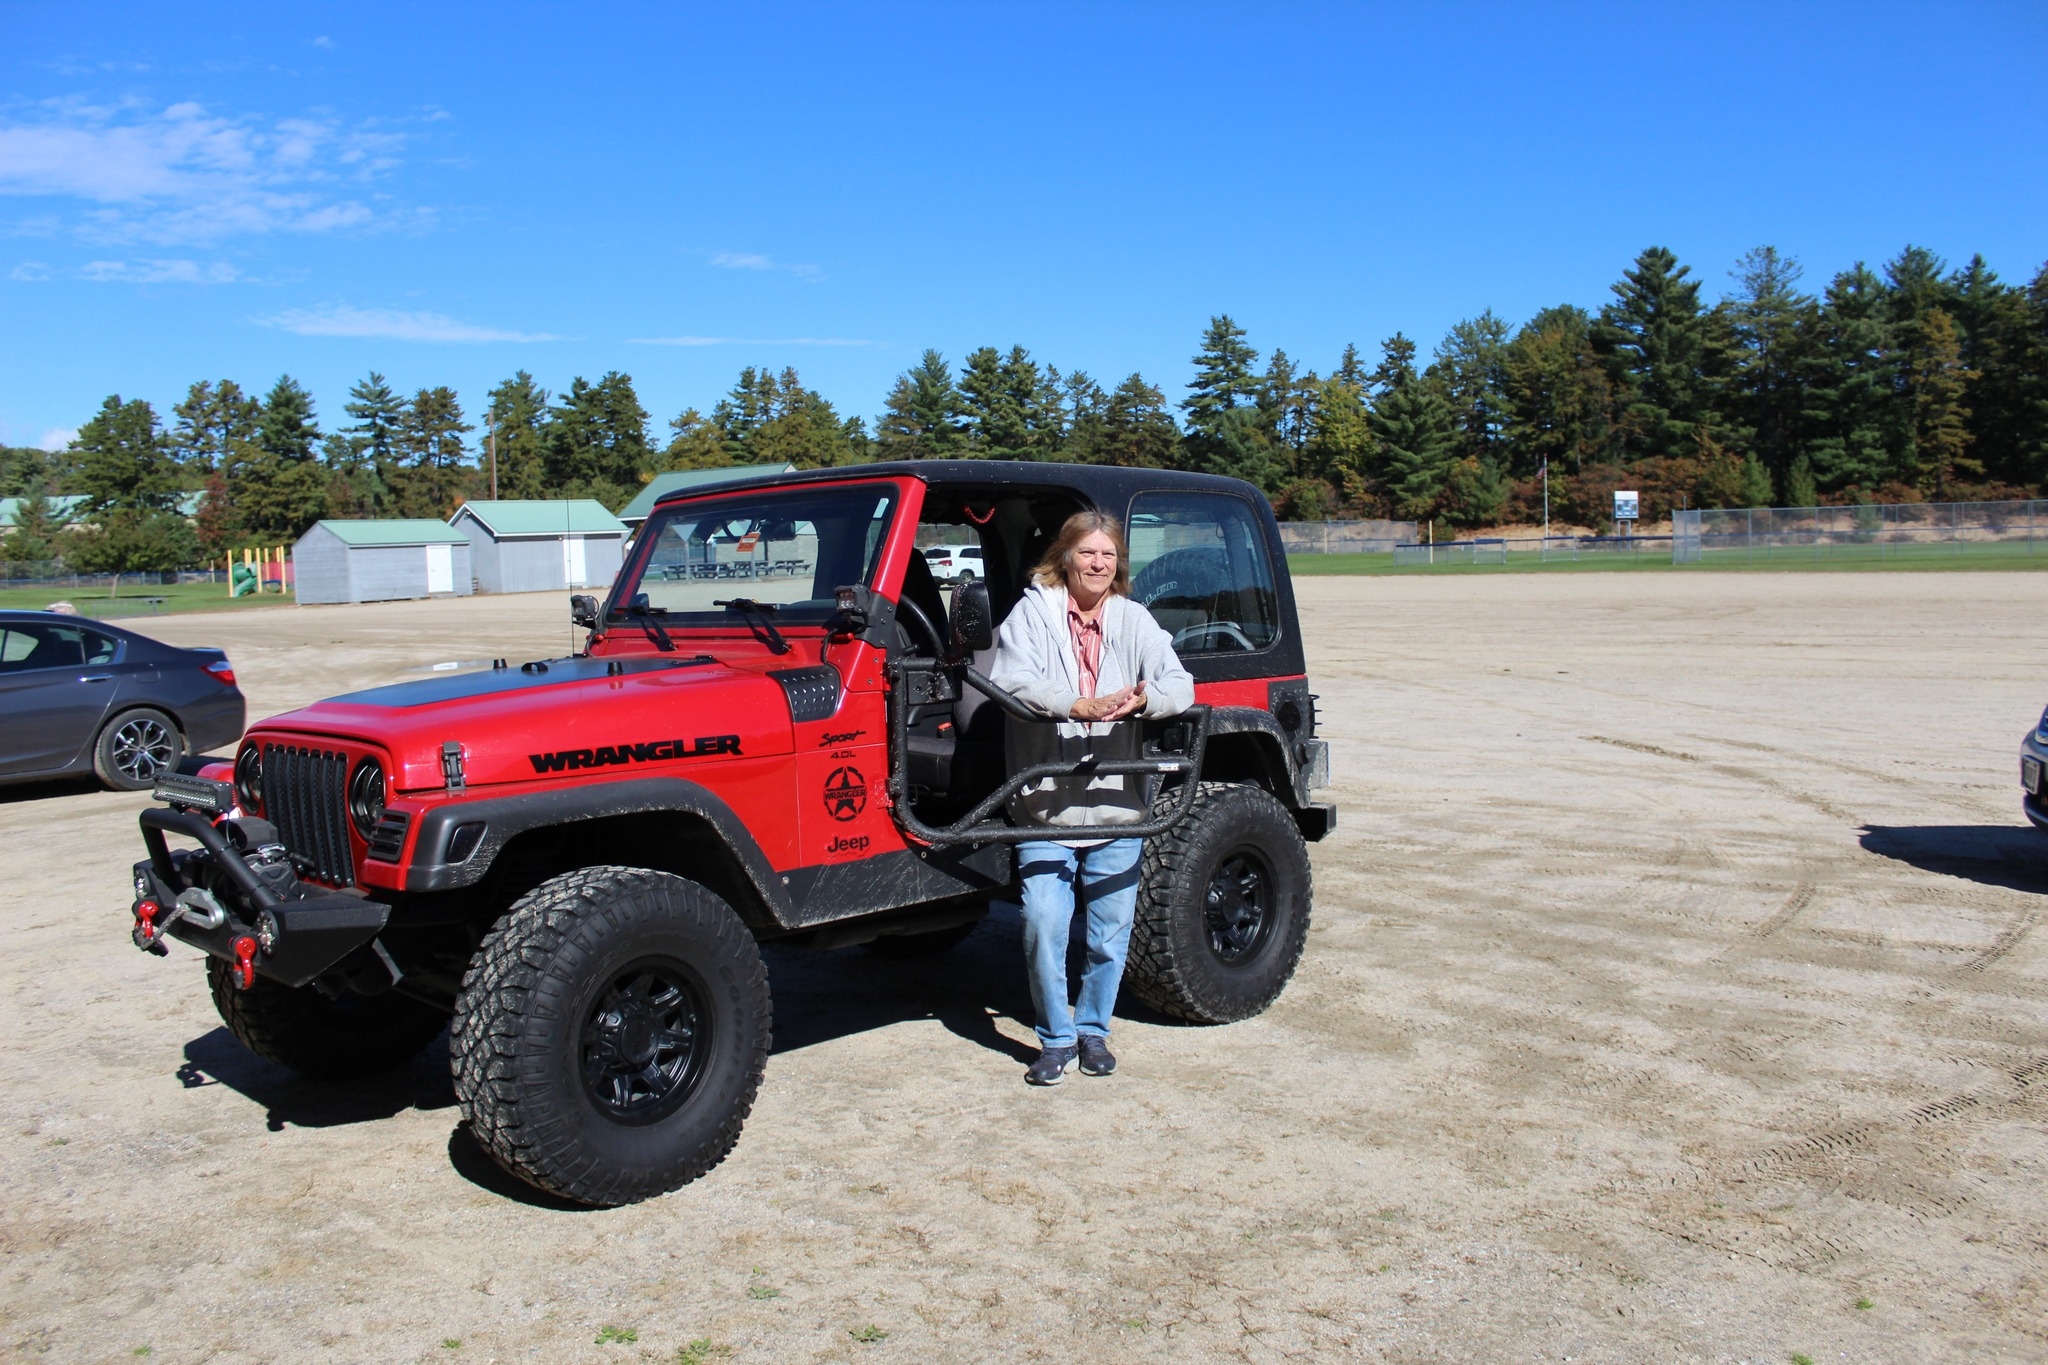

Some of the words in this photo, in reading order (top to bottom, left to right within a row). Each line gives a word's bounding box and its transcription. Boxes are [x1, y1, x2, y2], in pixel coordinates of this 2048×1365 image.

[529, 734, 744, 774] WRANGLER
[830, 750, 857, 760] 4.0L
[824, 787, 866, 801] WRANGLER
[827, 835, 870, 853] Jeep
